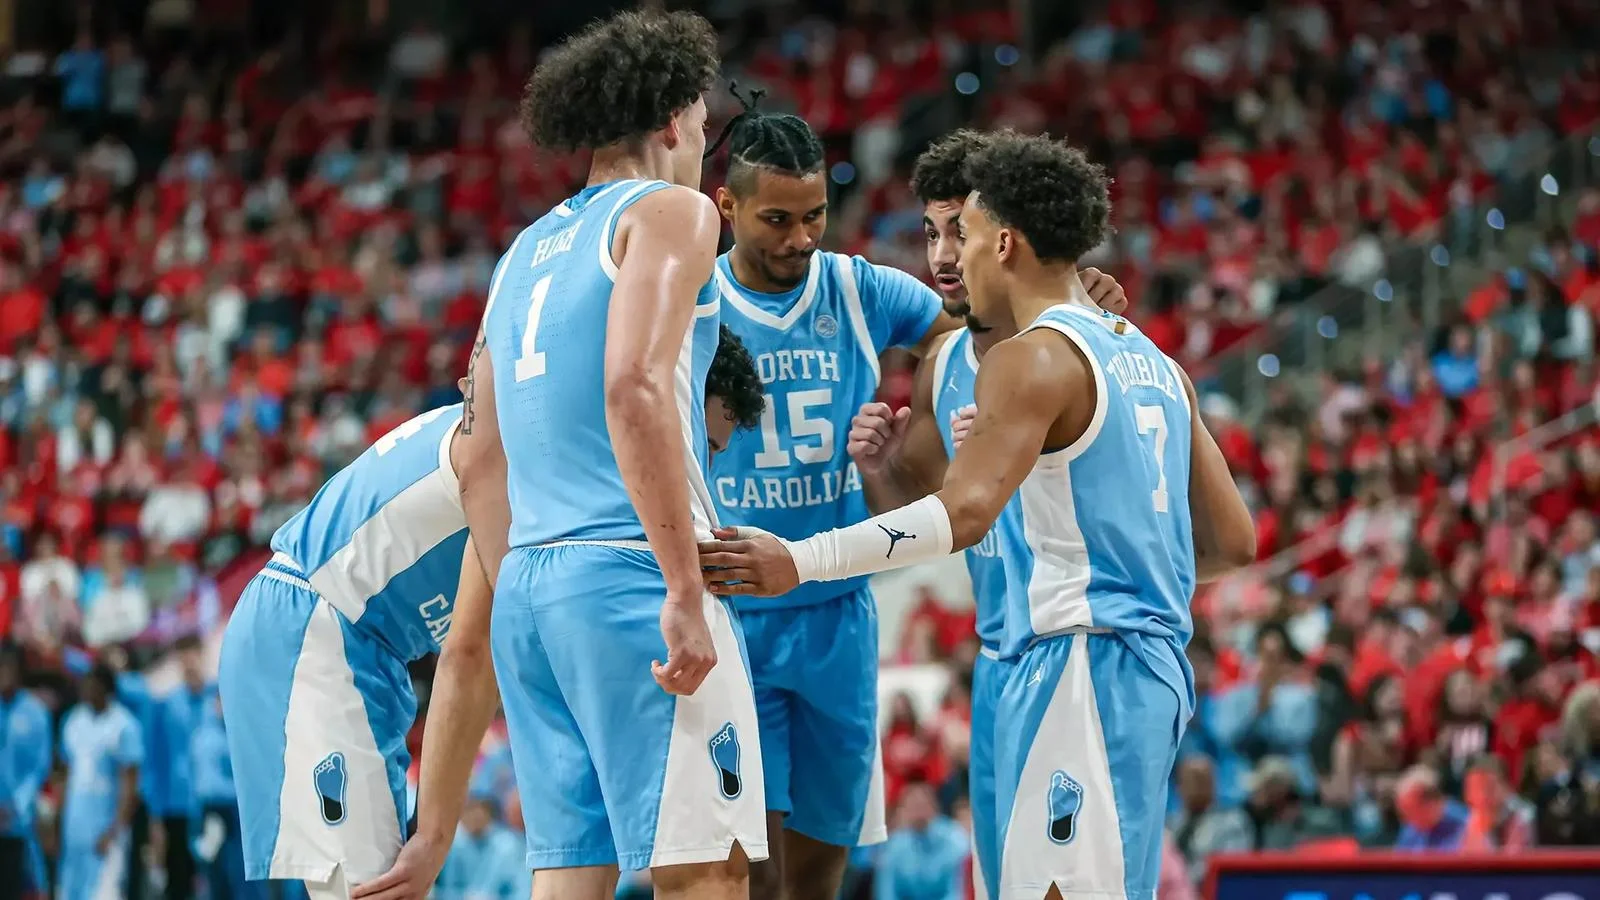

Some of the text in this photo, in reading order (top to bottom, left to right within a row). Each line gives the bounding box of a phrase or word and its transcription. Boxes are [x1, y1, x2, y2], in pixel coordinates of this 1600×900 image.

[515, 273, 553, 383] 1
[756, 349, 841, 384] ORTH
[755, 388, 834, 469] 15
[1134, 403, 1169, 513] 7
